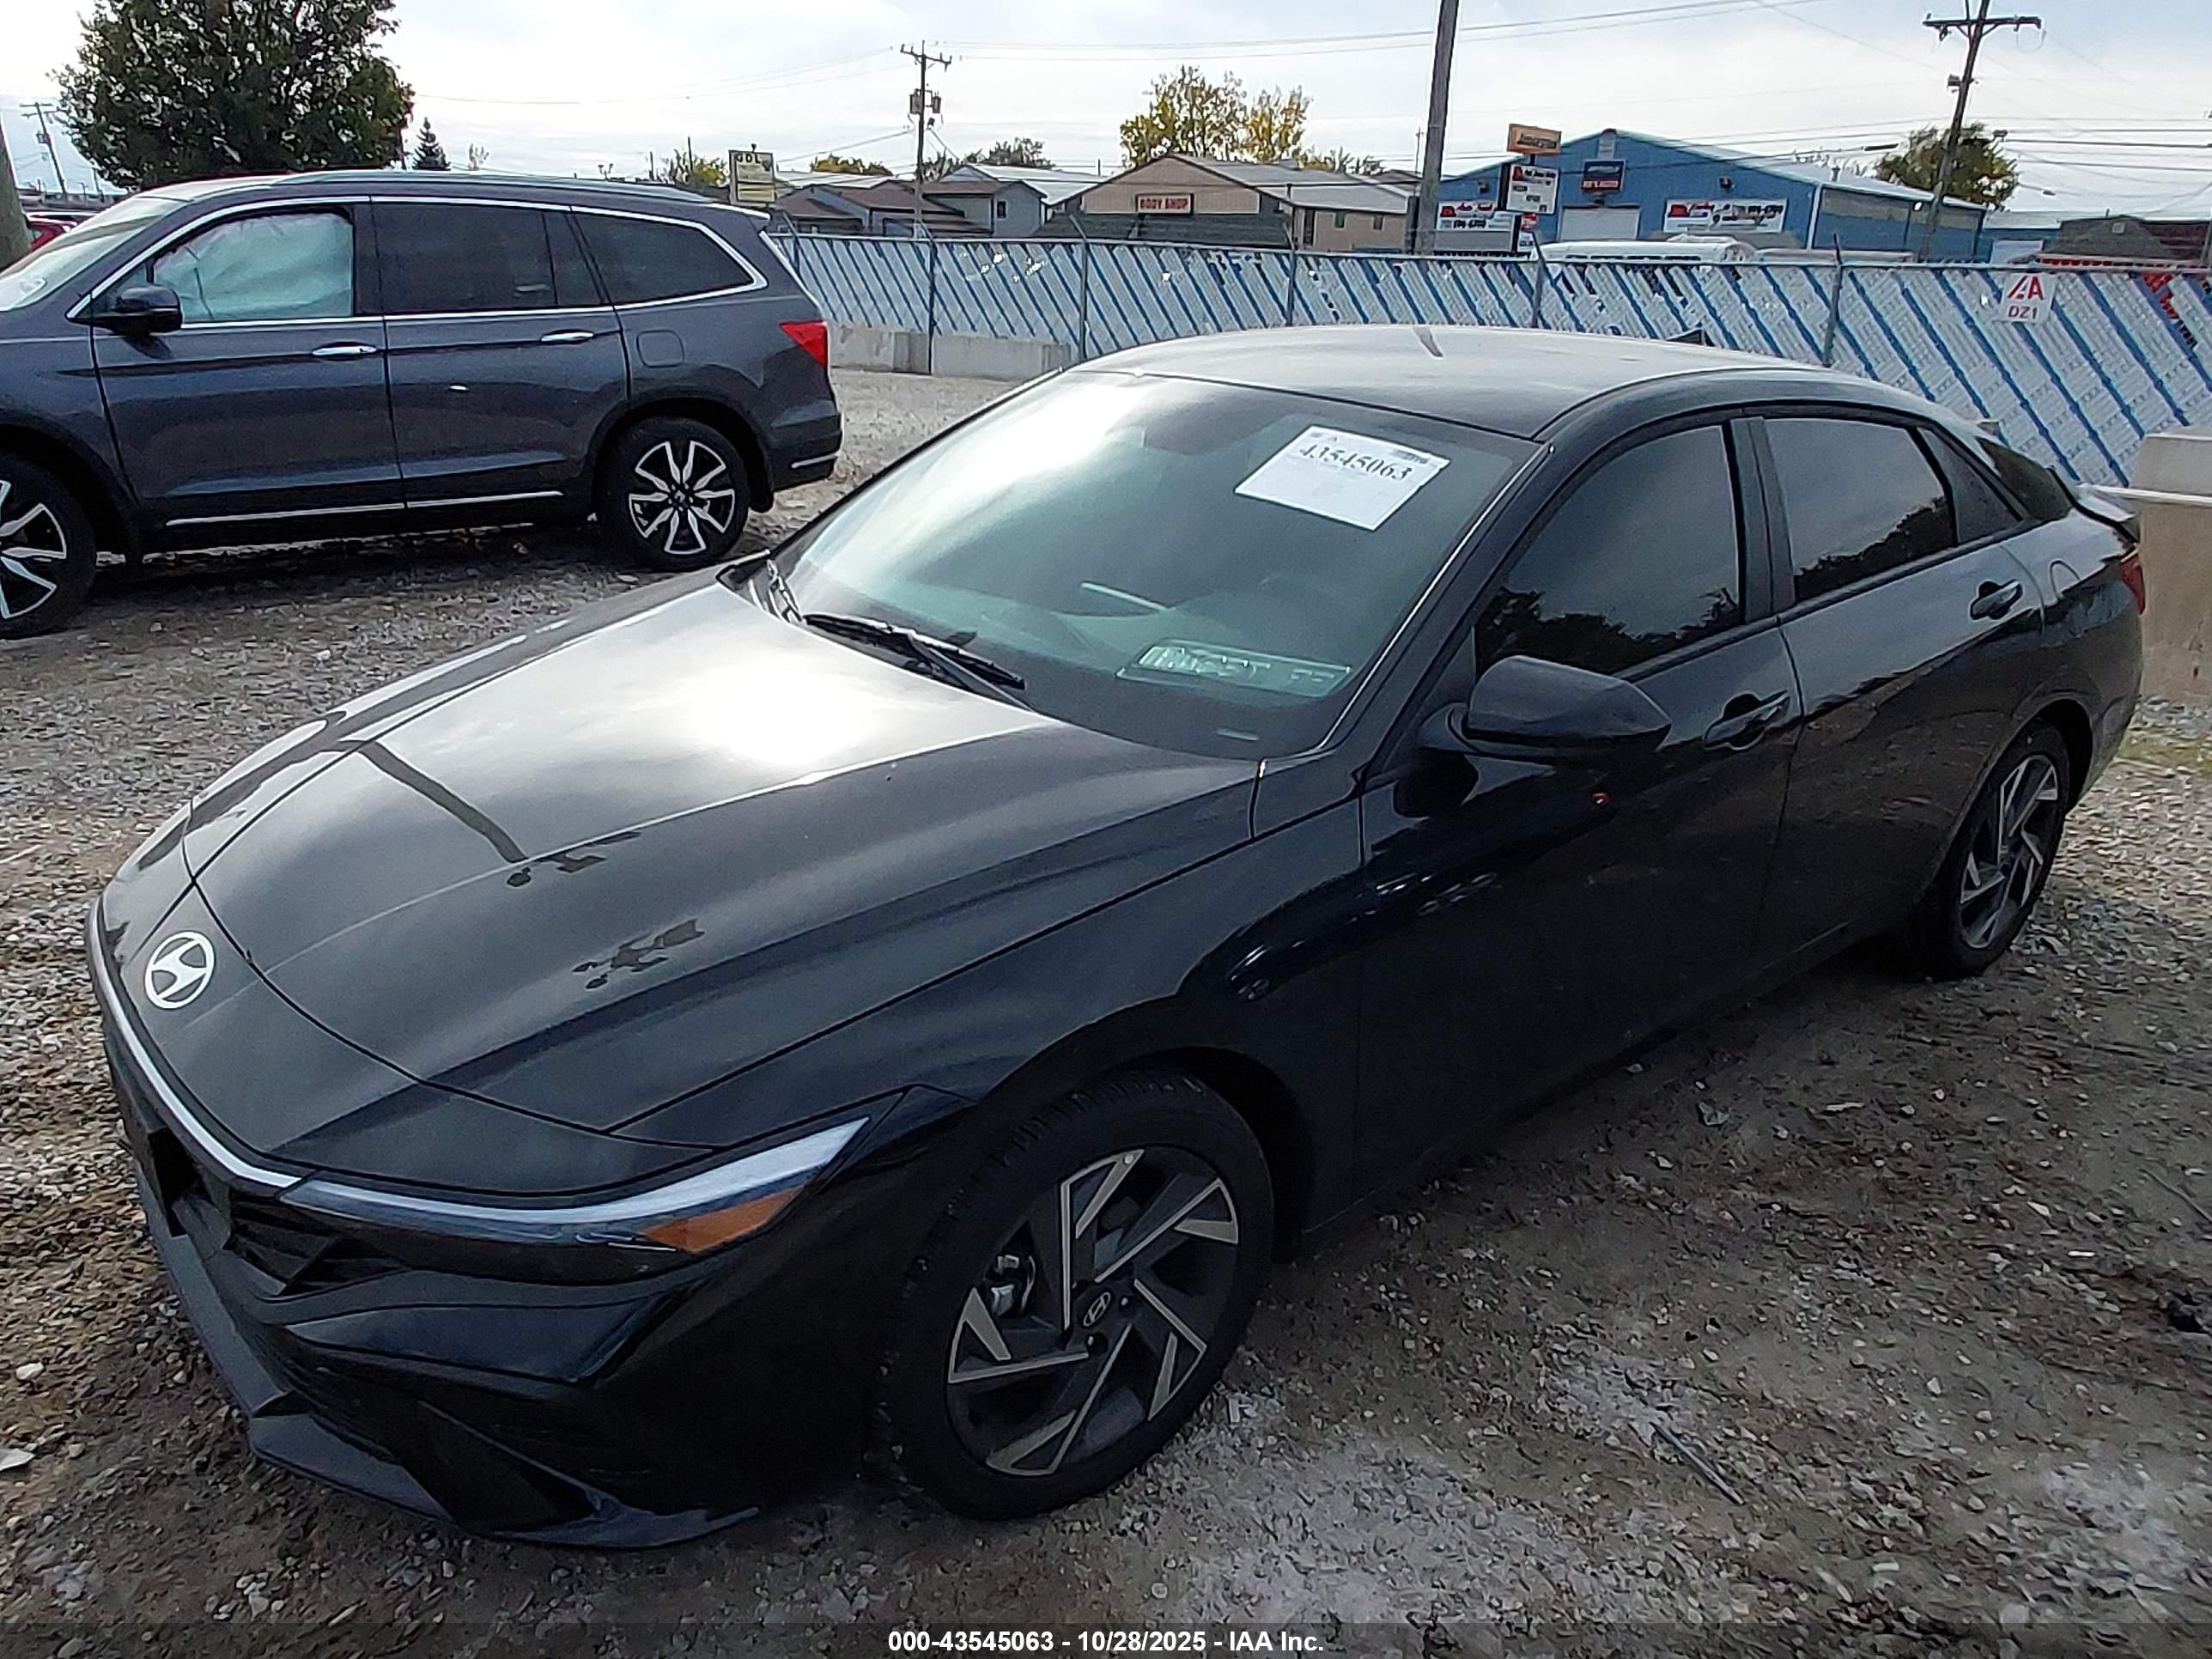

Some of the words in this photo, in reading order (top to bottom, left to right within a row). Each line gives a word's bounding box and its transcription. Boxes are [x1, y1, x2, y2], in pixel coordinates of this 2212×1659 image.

[1139, 198, 1163, 210] BODY
[1165, 198, 1188, 210] SHOP
[1300, 443, 1413, 480] 43545063
